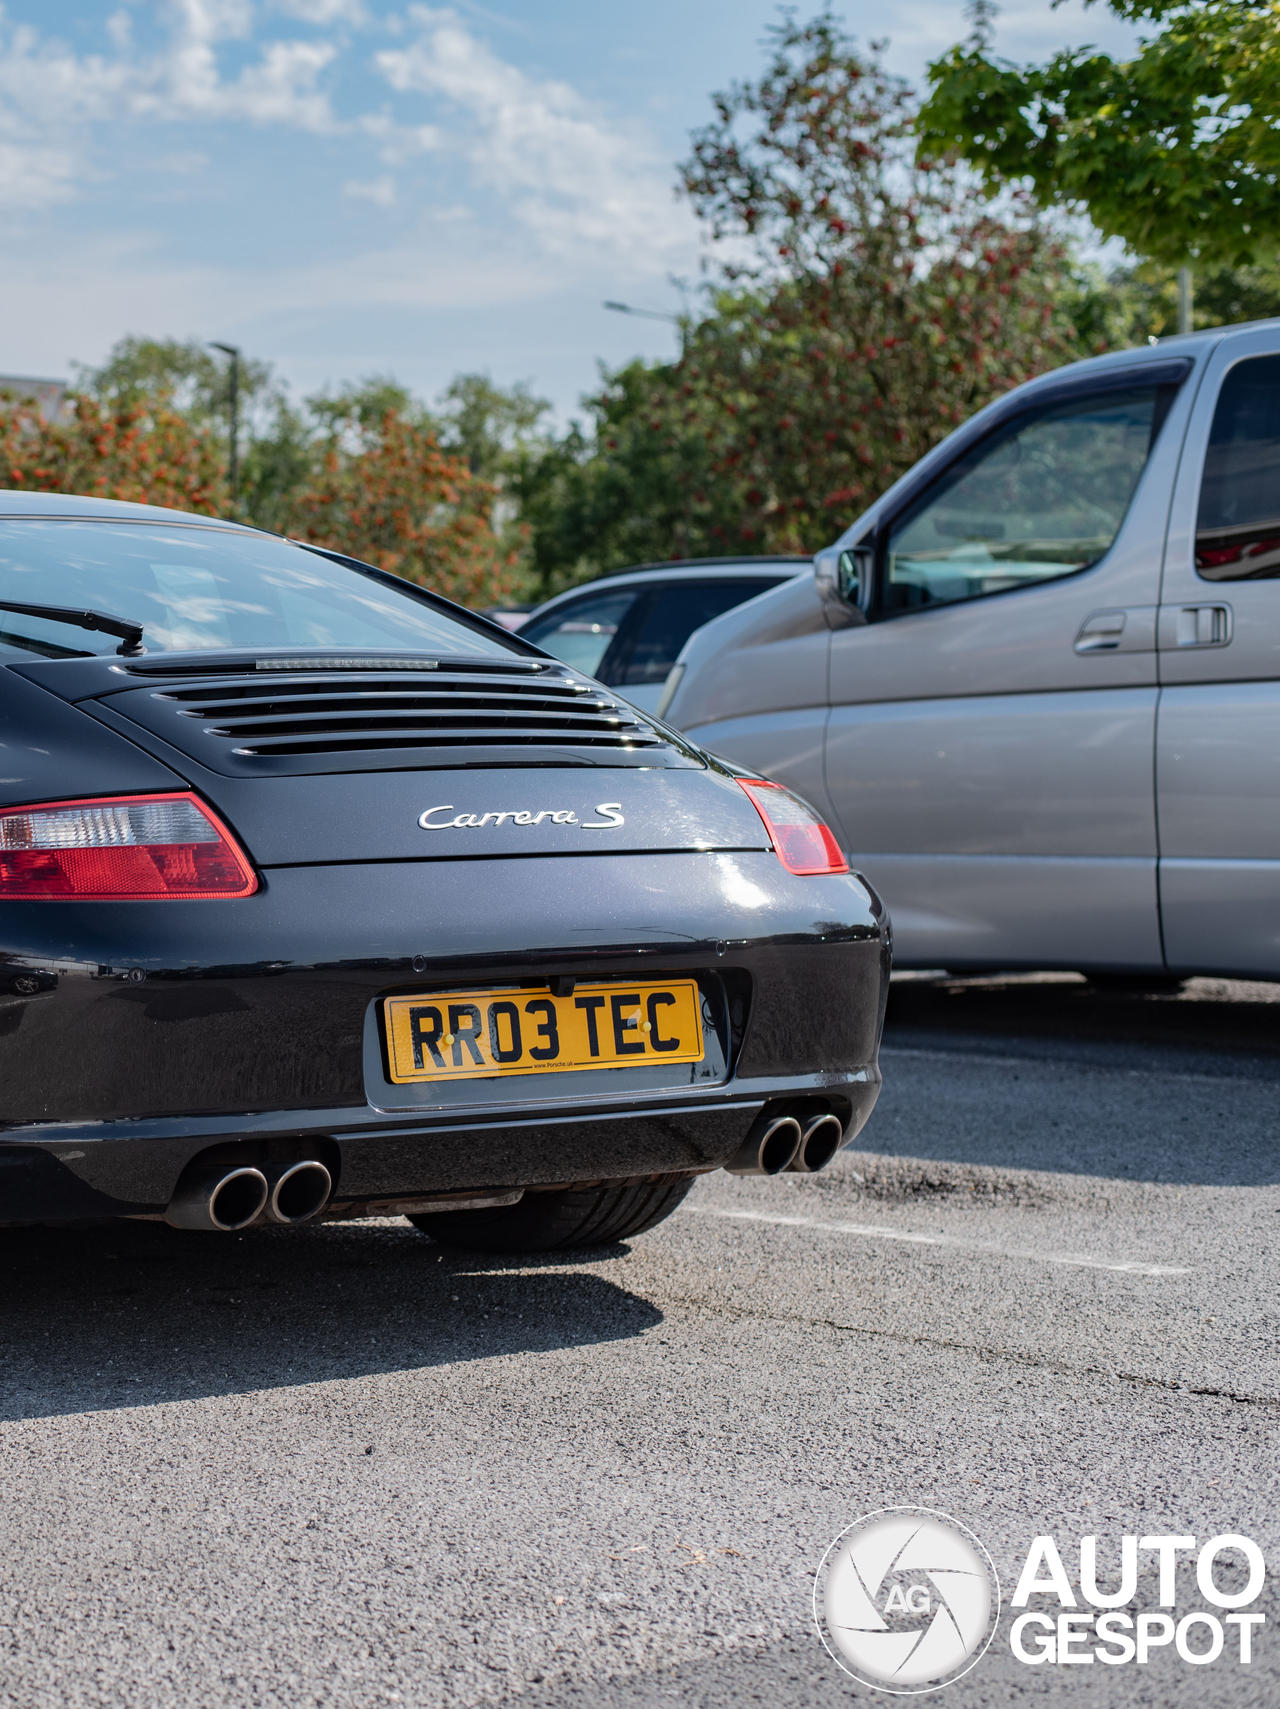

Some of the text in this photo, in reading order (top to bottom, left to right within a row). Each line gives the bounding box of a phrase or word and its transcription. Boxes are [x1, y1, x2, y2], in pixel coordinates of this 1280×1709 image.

[418, 803, 625, 830] Carrera S
[409, 992, 680, 1069] RR03 TEC
